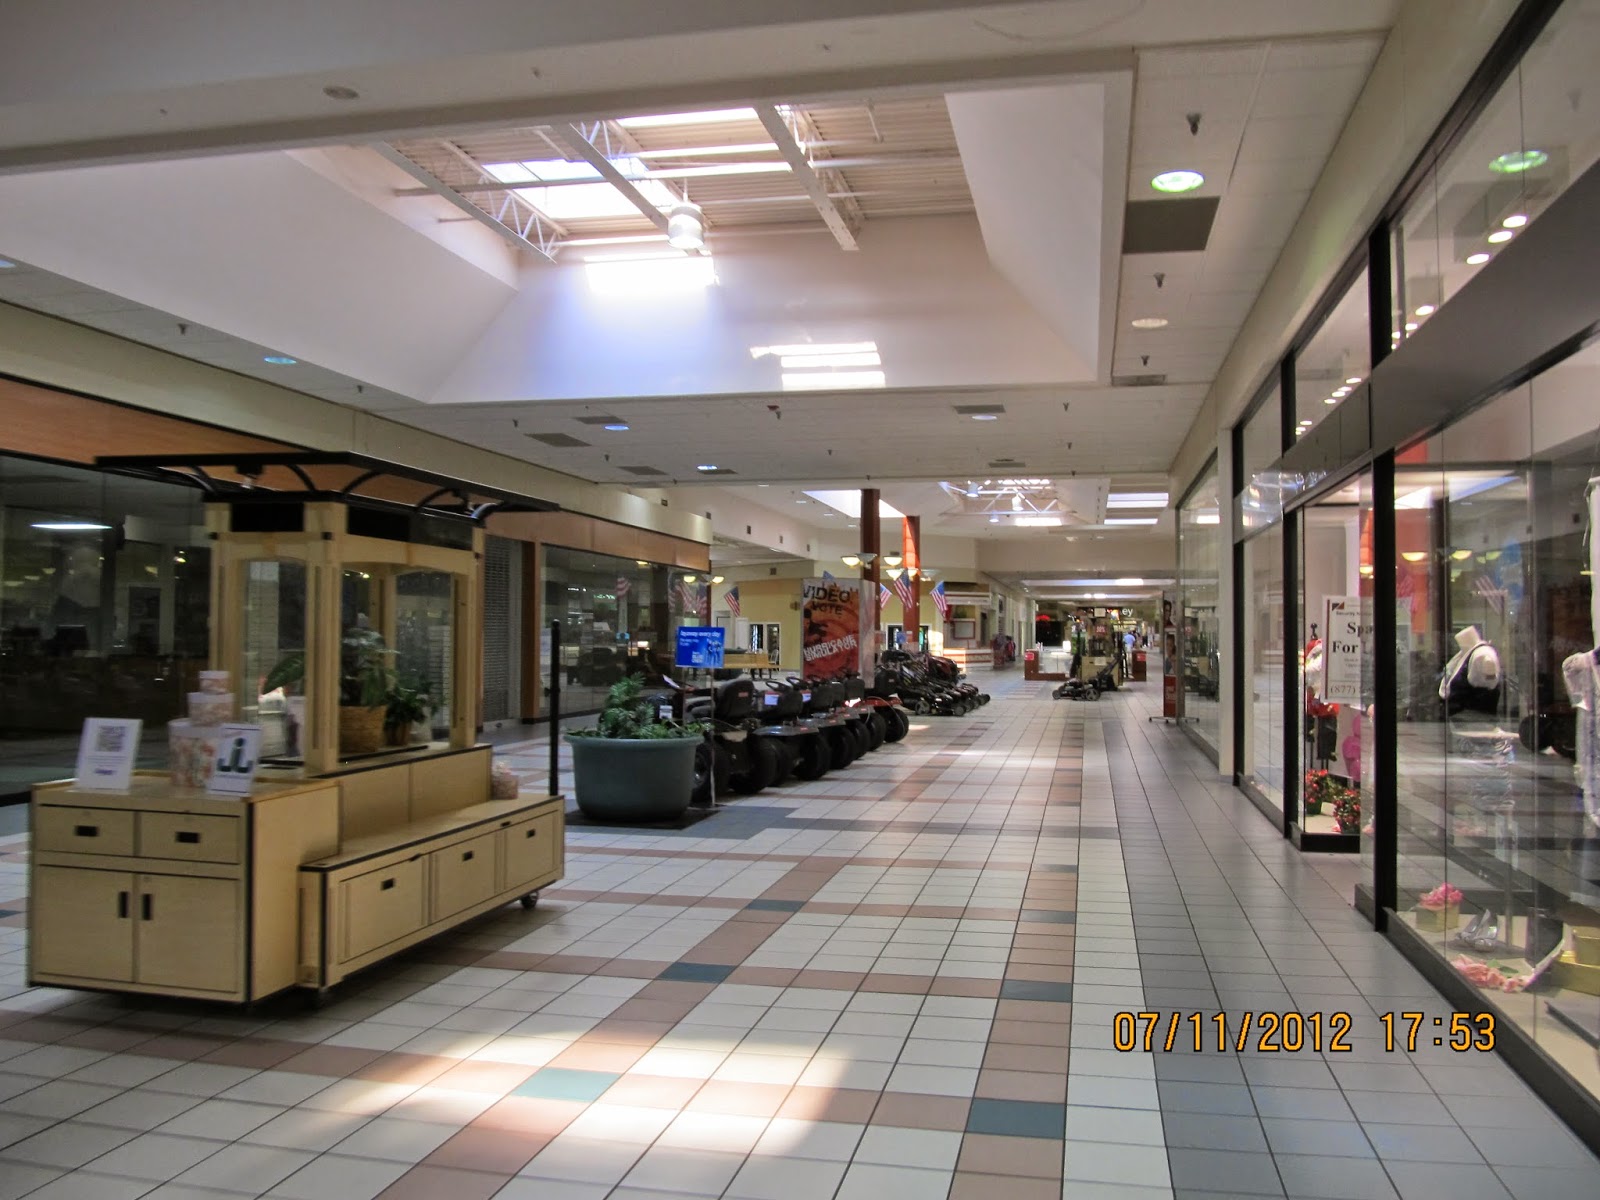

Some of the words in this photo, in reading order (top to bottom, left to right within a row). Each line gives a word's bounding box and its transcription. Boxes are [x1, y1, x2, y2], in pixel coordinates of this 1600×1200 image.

[803, 585, 850, 602] VIDEO
[812, 600, 843, 615] VOTE
[1347, 621, 1373, 637] Spa
[805, 639, 858, 661] SIMULATOR
[1332, 641, 1359, 653] For
[1330, 685, 1356, 694] (877)
